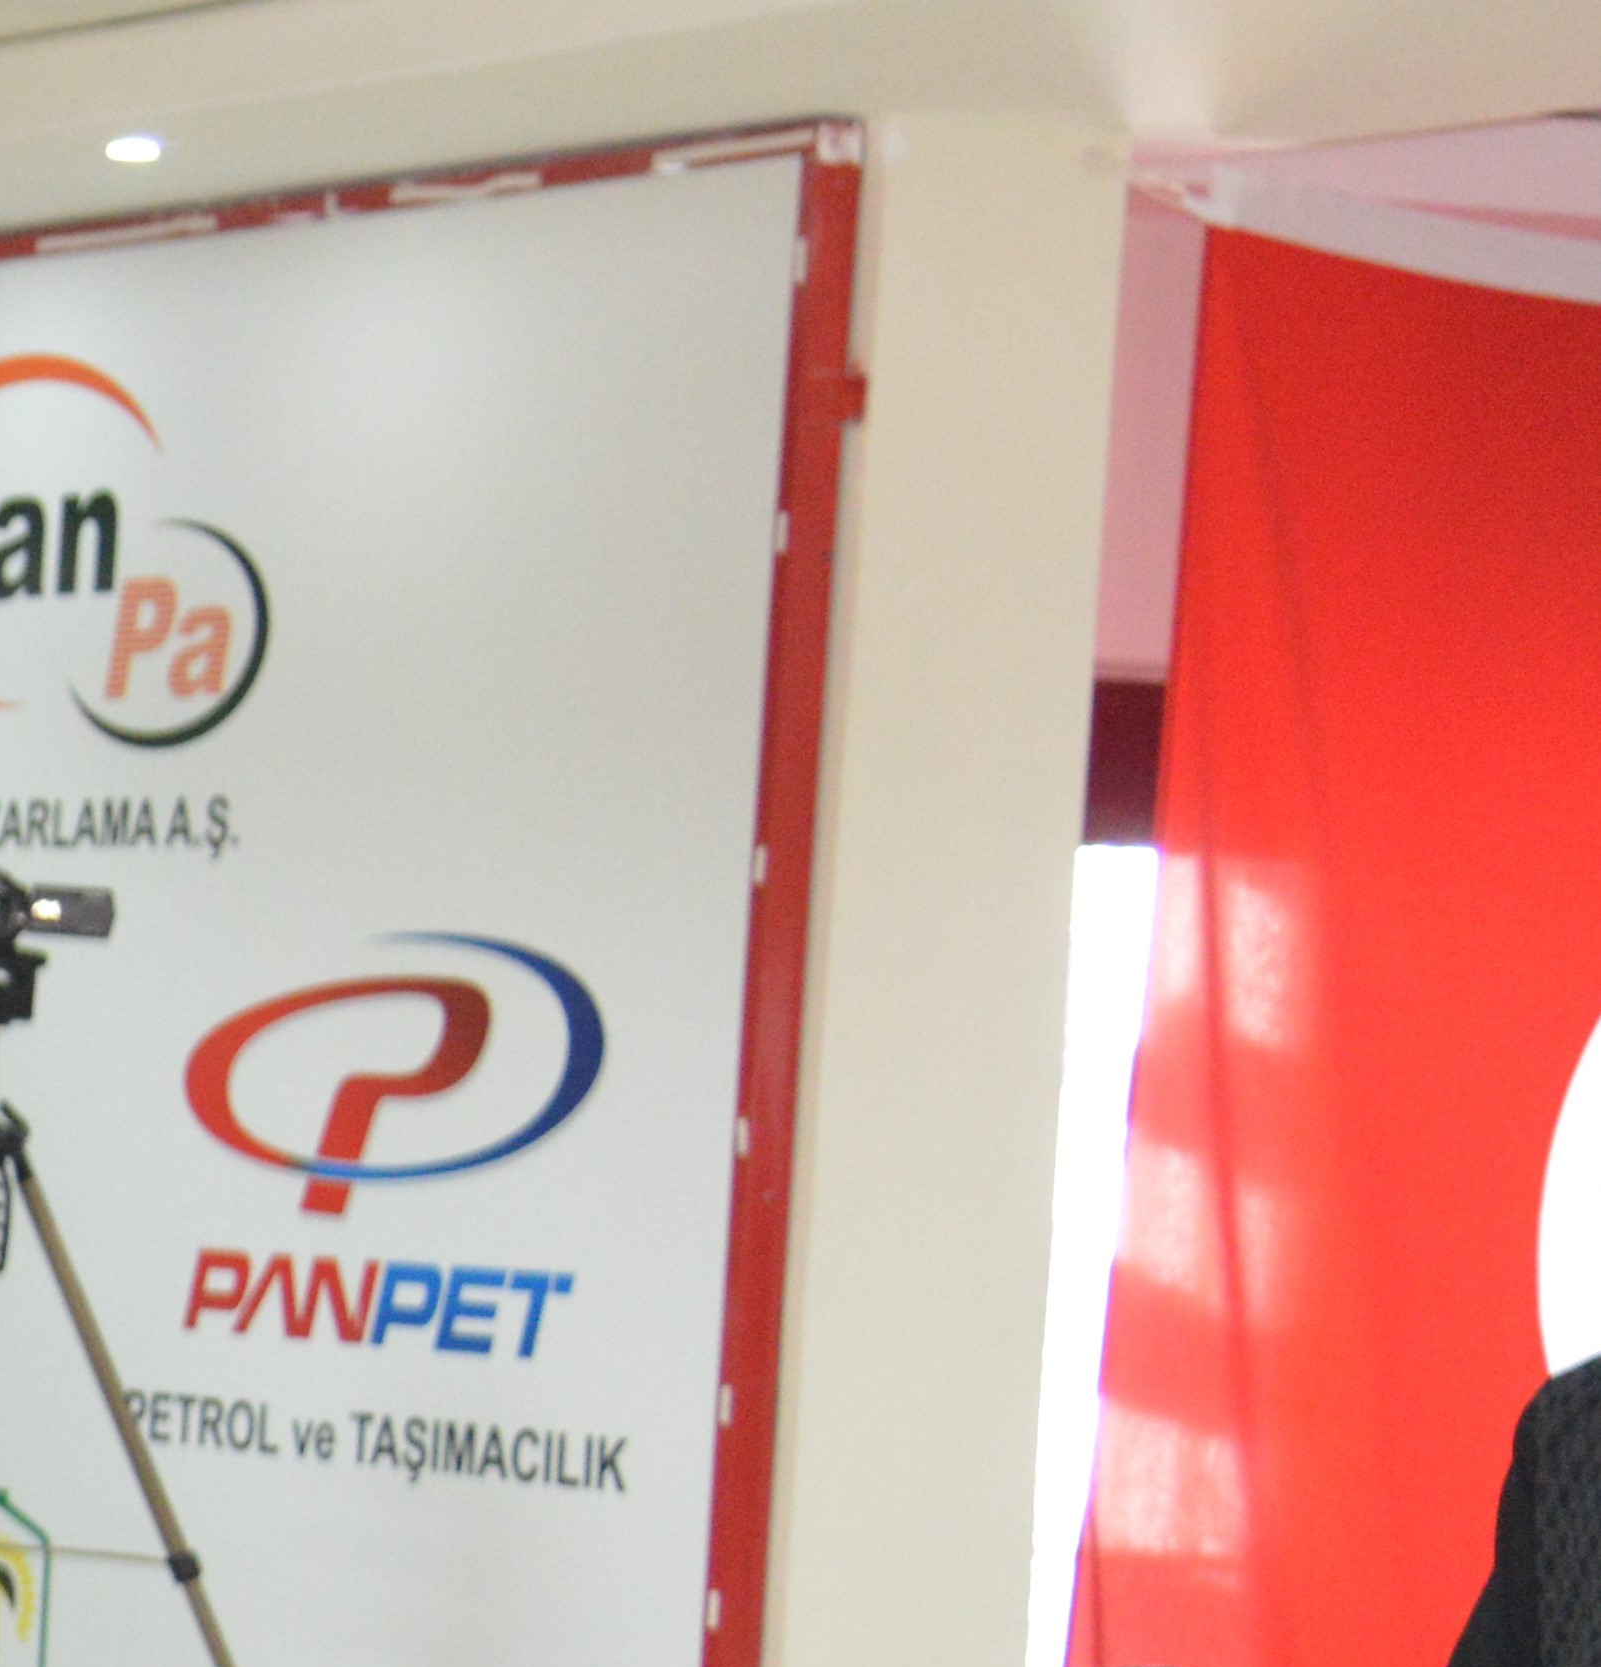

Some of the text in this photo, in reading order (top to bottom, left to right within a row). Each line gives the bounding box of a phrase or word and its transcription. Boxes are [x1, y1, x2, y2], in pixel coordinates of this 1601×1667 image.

[104, 575, 231, 701] Pa
[165, 796, 239, 858] A.Ş.
[181, 1246, 575, 1358] PANPET
[120, 1388, 629, 1493] PETROL ve TAŞIMACILIK
